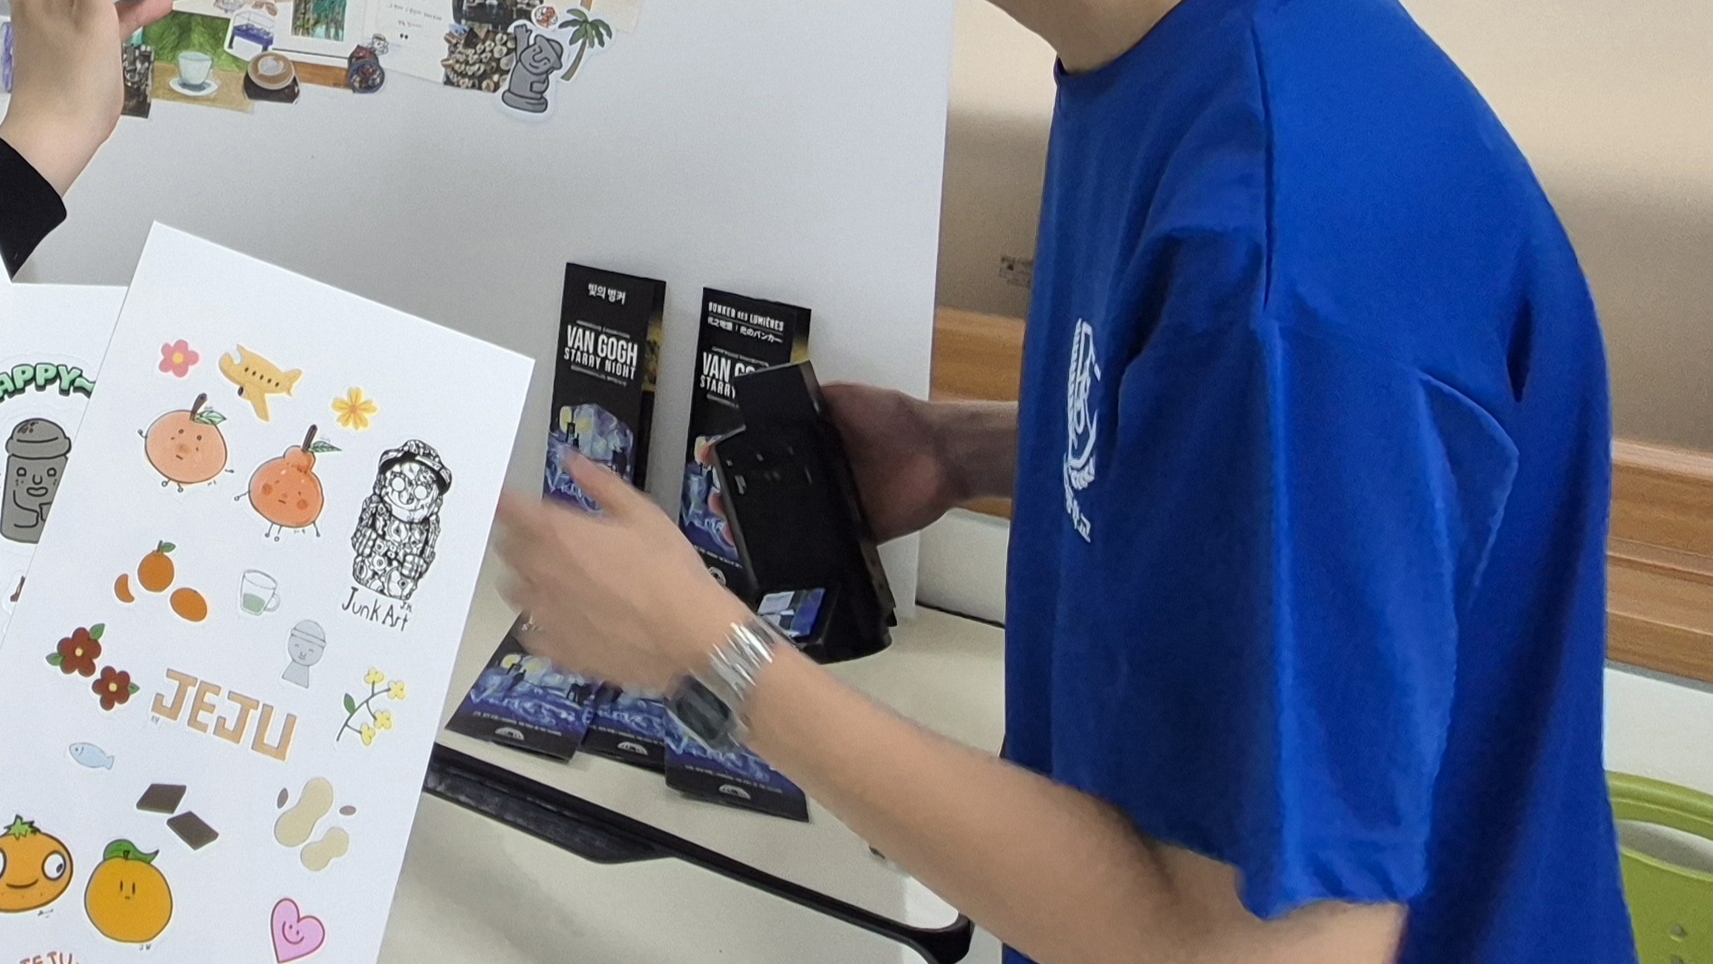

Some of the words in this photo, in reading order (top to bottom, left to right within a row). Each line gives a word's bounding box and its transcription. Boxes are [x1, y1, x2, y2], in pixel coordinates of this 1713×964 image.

[588, 283, 607, 299] 빛의
[607, 288, 626, 305] 벙커
[564, 347, 601, 370] STARRY
[604, 359, 636, 380] NIGHT
[567, 324, 595, 353] VAN
[597, 334, 638, 368] GOGH
[703, 352, 731, 383] VAN
[342, 586, 381, 622] Junk
[381, 603, 408, 631] Art
[151, 668, 297, 761] JEJU
